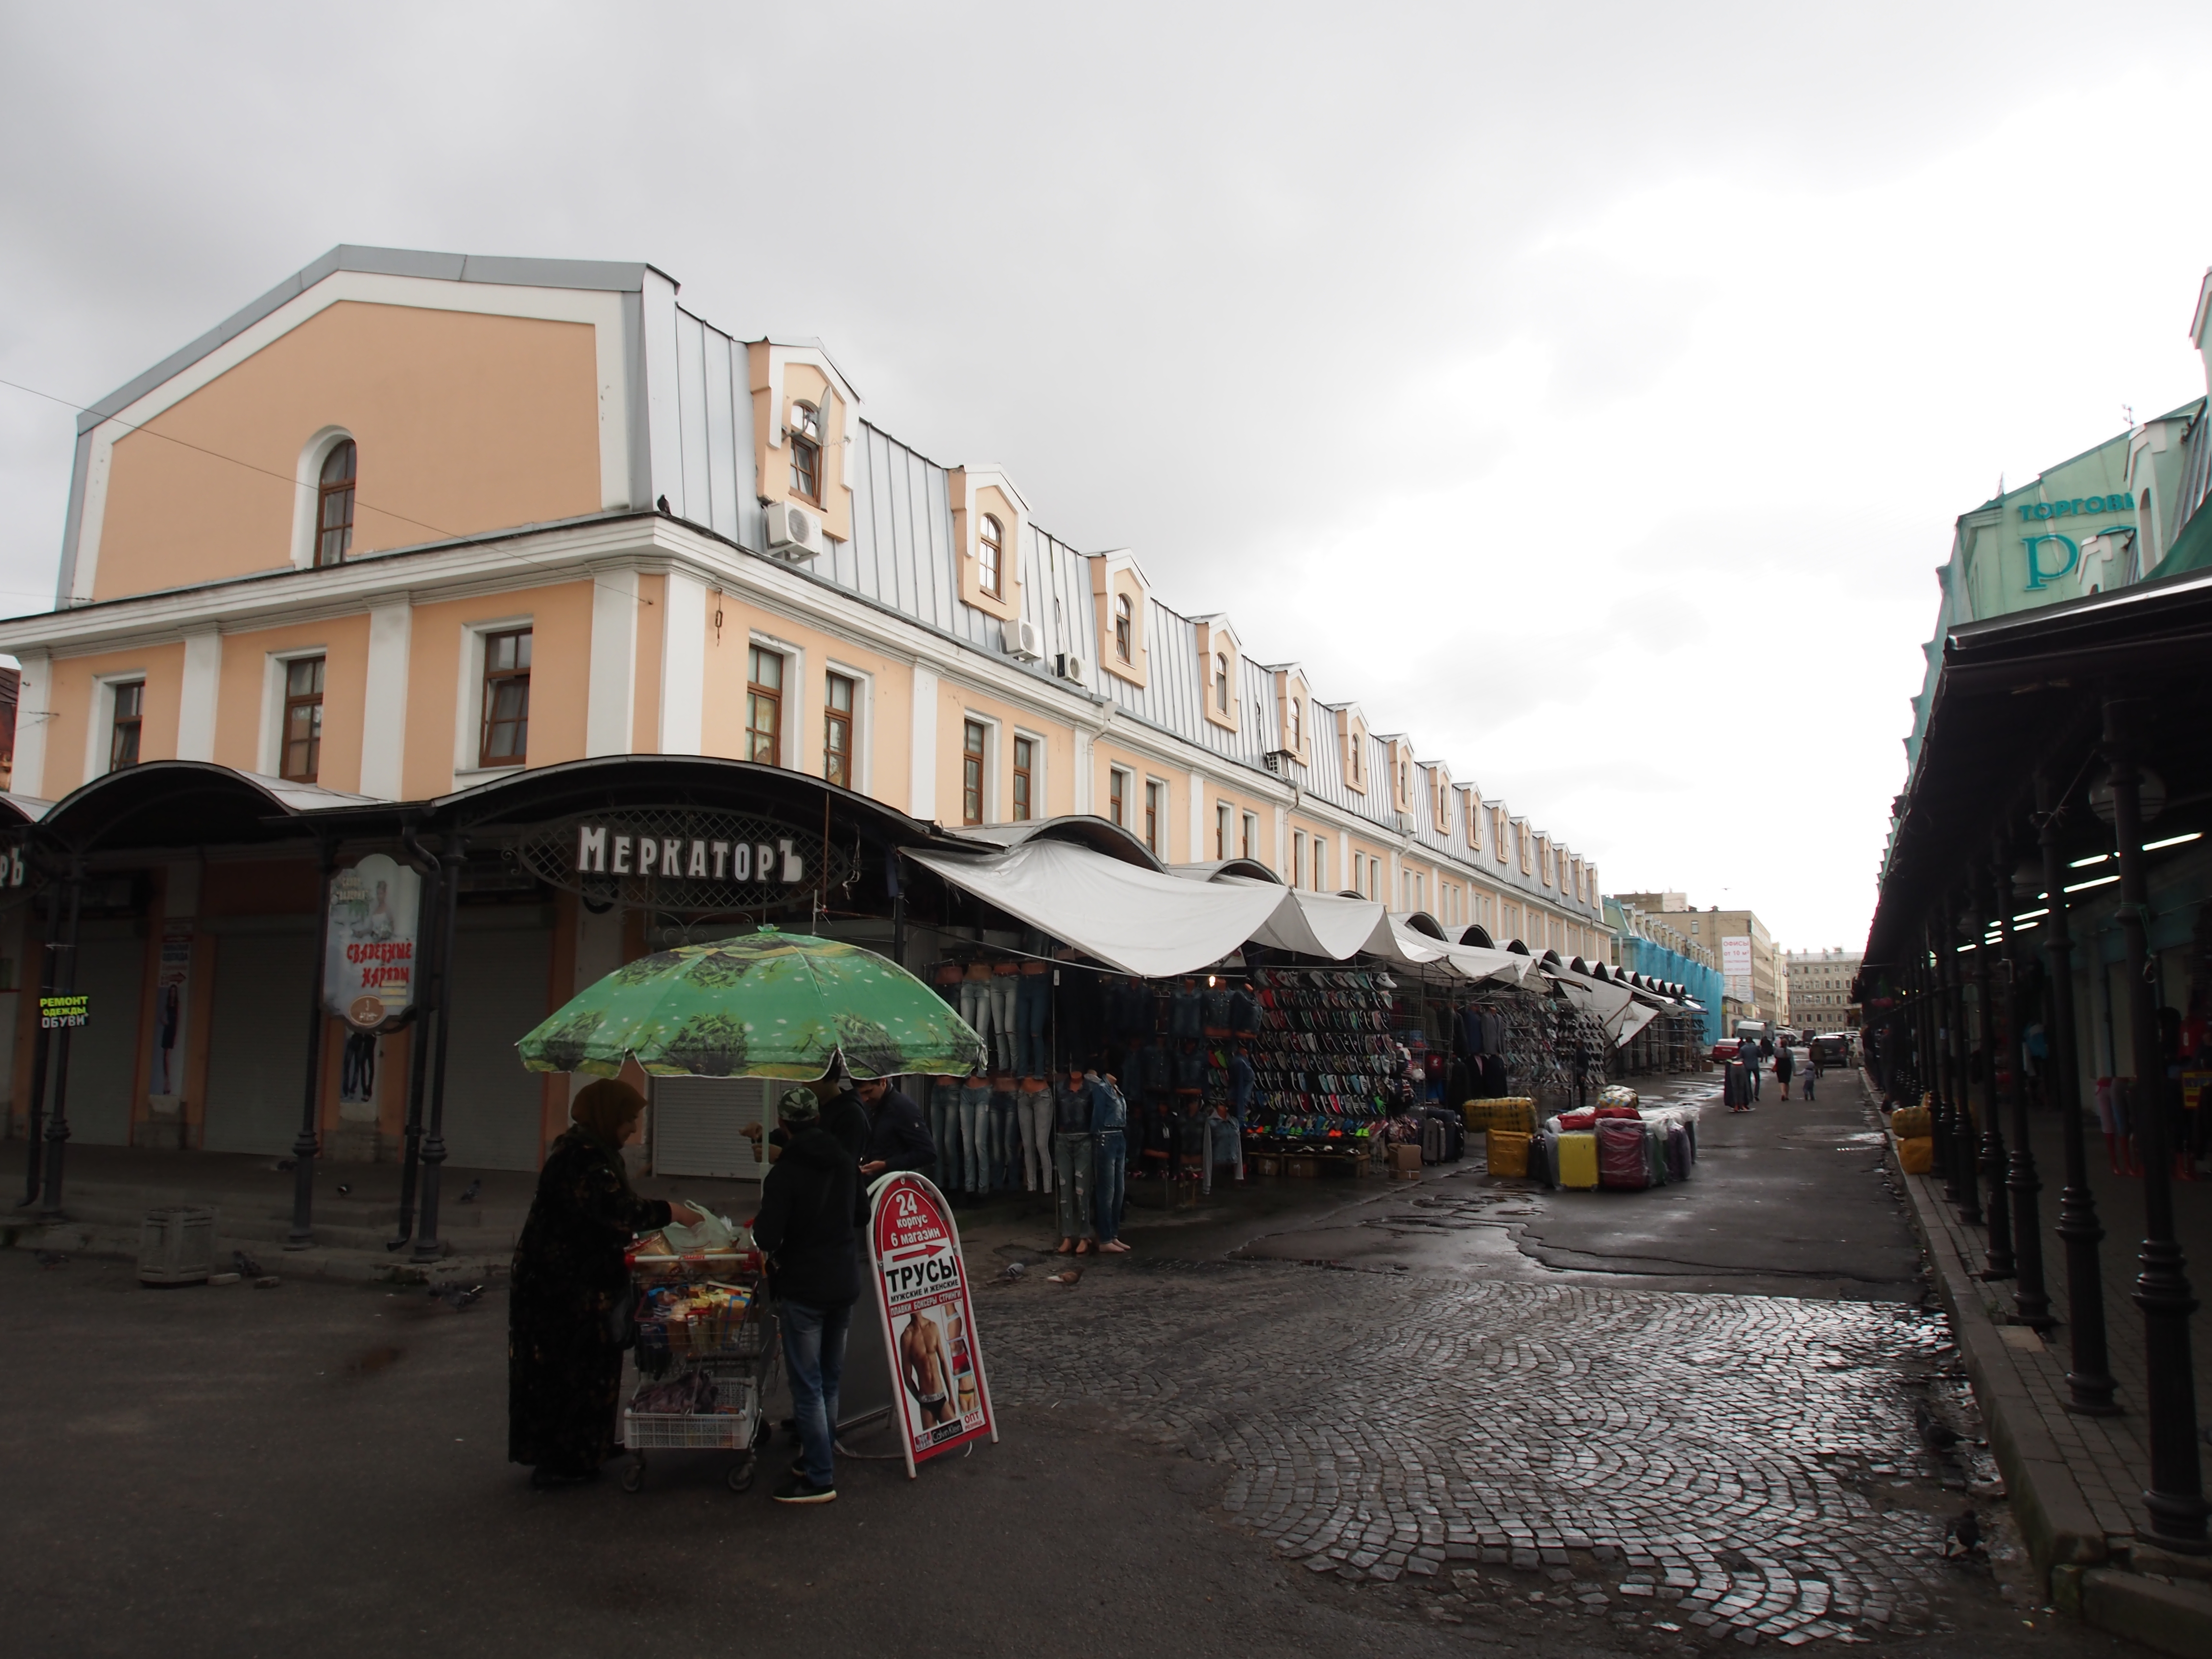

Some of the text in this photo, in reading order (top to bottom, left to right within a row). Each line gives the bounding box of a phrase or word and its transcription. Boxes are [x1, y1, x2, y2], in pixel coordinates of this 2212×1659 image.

[39, 996, 88, 1007] РЕМОНТ
[43, 1006, 86, 1017] ОДЕЖДЫ
[41, 1015, 85, 1028] ОБУВИ
[896, 1192, 918, 1217] 24
[896, 1214, 928, 1229] корпус
[890, 1227, 941, 1247] 6 магазин
[886, 1256, 957, 1292] ТРУСЫ
[891, 1289, 922, 1303] МУЖСКИЕ
[930, 1279, 959, 1292] ЖЕНСКИЕ
[890, 1290, 962, 1315] ПЛАВКИ БОКСЕРЫ СТРИНГИ
[964, 1411, 979, 1423] ОПТ
[932, 1428, 949, 1441] Calvin
[949, 1424, 962, 1436] Klein
